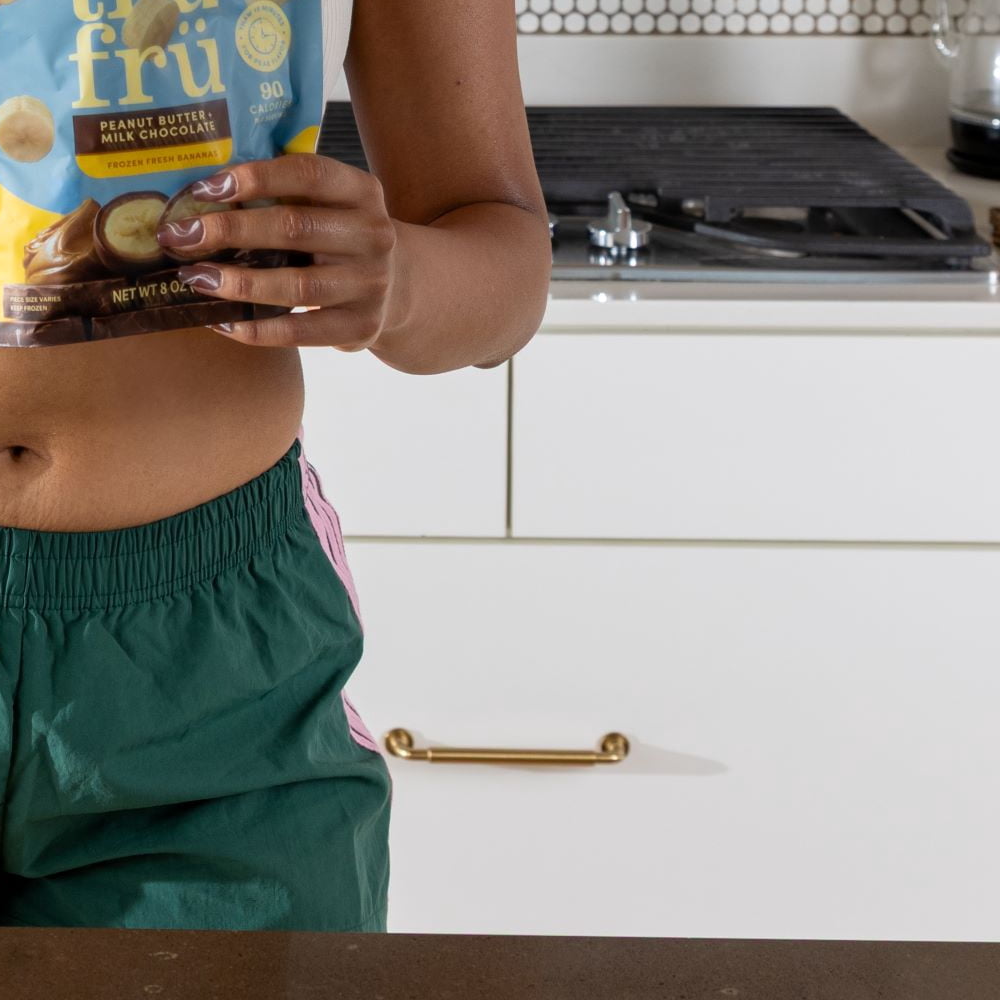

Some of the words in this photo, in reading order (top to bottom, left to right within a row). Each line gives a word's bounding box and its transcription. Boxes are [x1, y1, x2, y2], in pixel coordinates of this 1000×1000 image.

[68, 18, 226, 109] frü
[260, 80, 284, 100] 90
[100, 116, 153, 132] PEANUT
[158, 110, 206, 126] BUTTER
[101, 130, 134, 144] MILK
[139, 121, 216, 140] CHOCOLATE
[107, 159, 144, 169] FROZEN
[146, 155, 175, 165] FRESH
[38, 295, 61, 303] VARIES
[112, 287, 137, 303] NET
[138, 283, 158, 298] WT
[160, 282, 168, 295] 8
